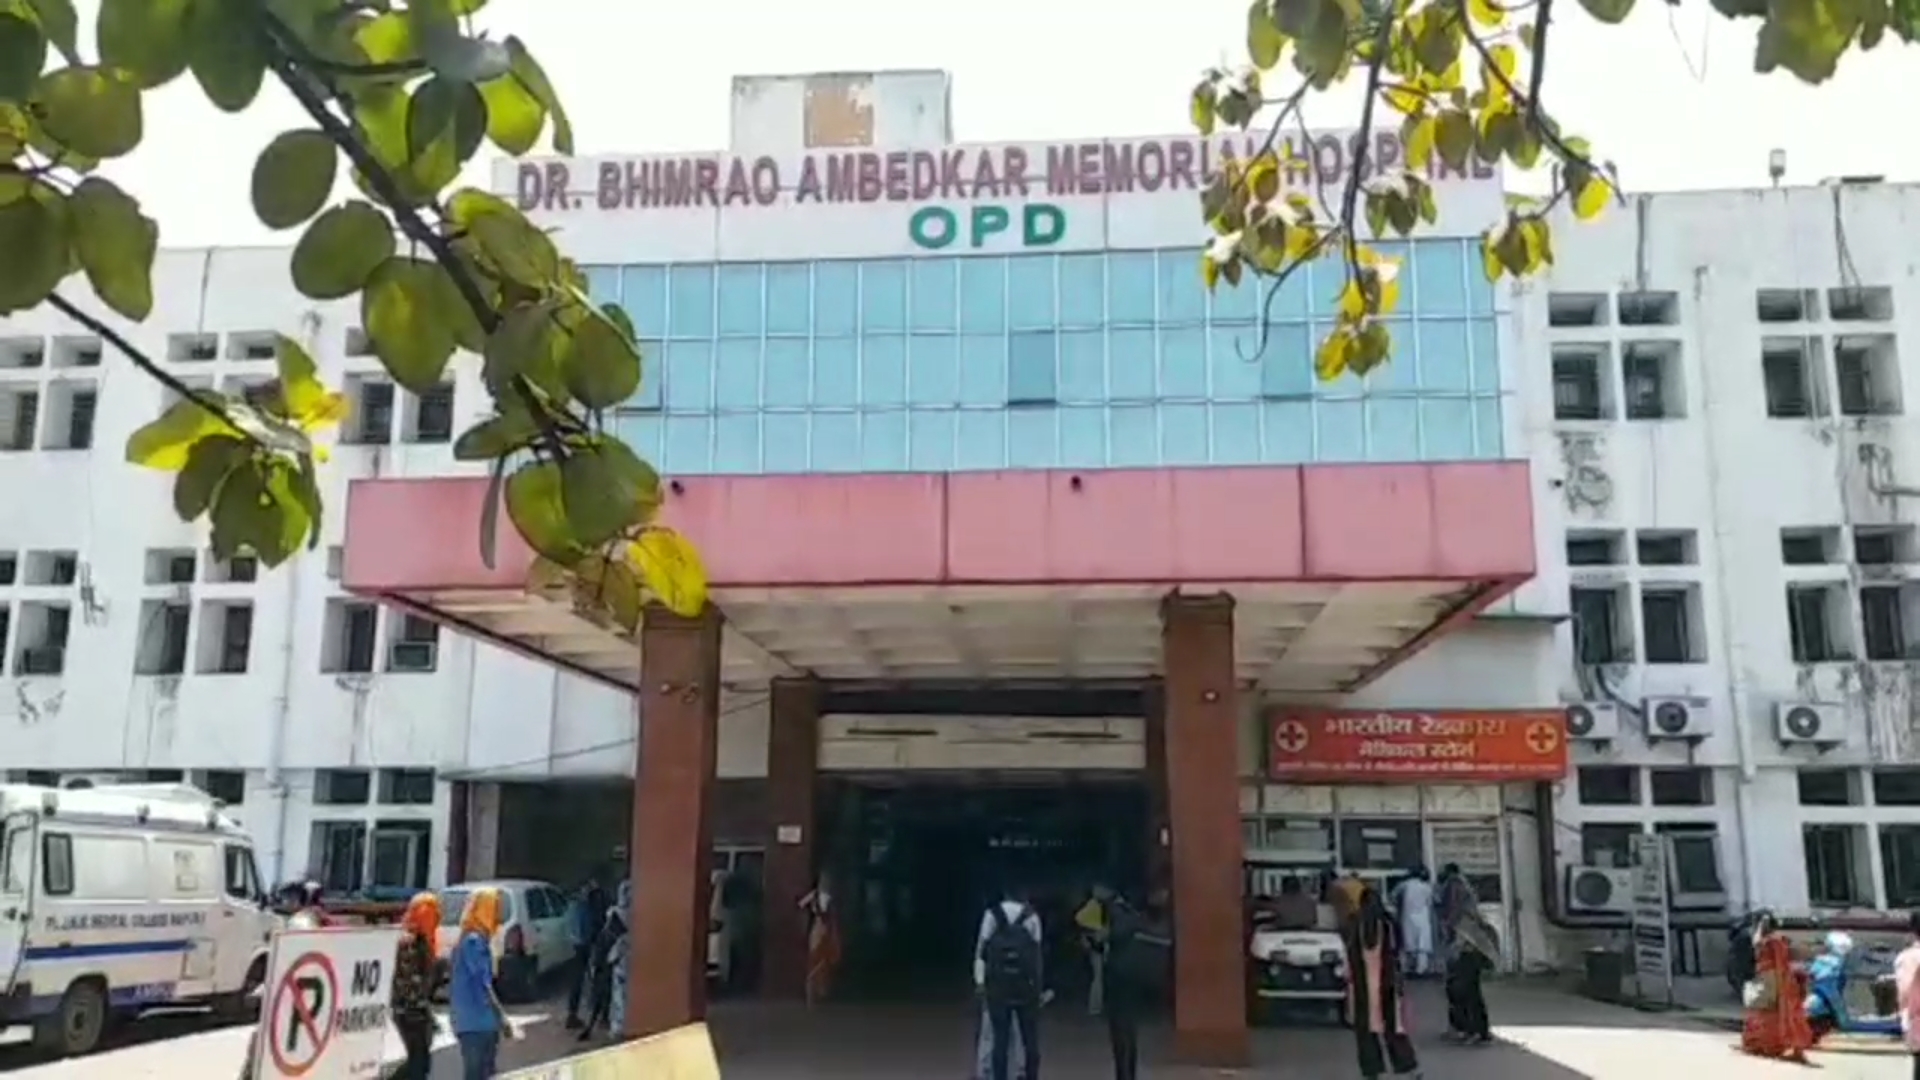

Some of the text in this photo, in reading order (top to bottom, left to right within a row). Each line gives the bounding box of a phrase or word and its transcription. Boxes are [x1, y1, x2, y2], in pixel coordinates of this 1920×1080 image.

[517, 162, 583, 211] DR.
[599, 156, 780, 211] BHIMRAO
[796, 146, 1028, 205] AMBEDKAR
[909, 203, 1067, 249] OPD
[1325, 713, 1413, 736] भारतीय
[351, 959, 380, 996] NO
